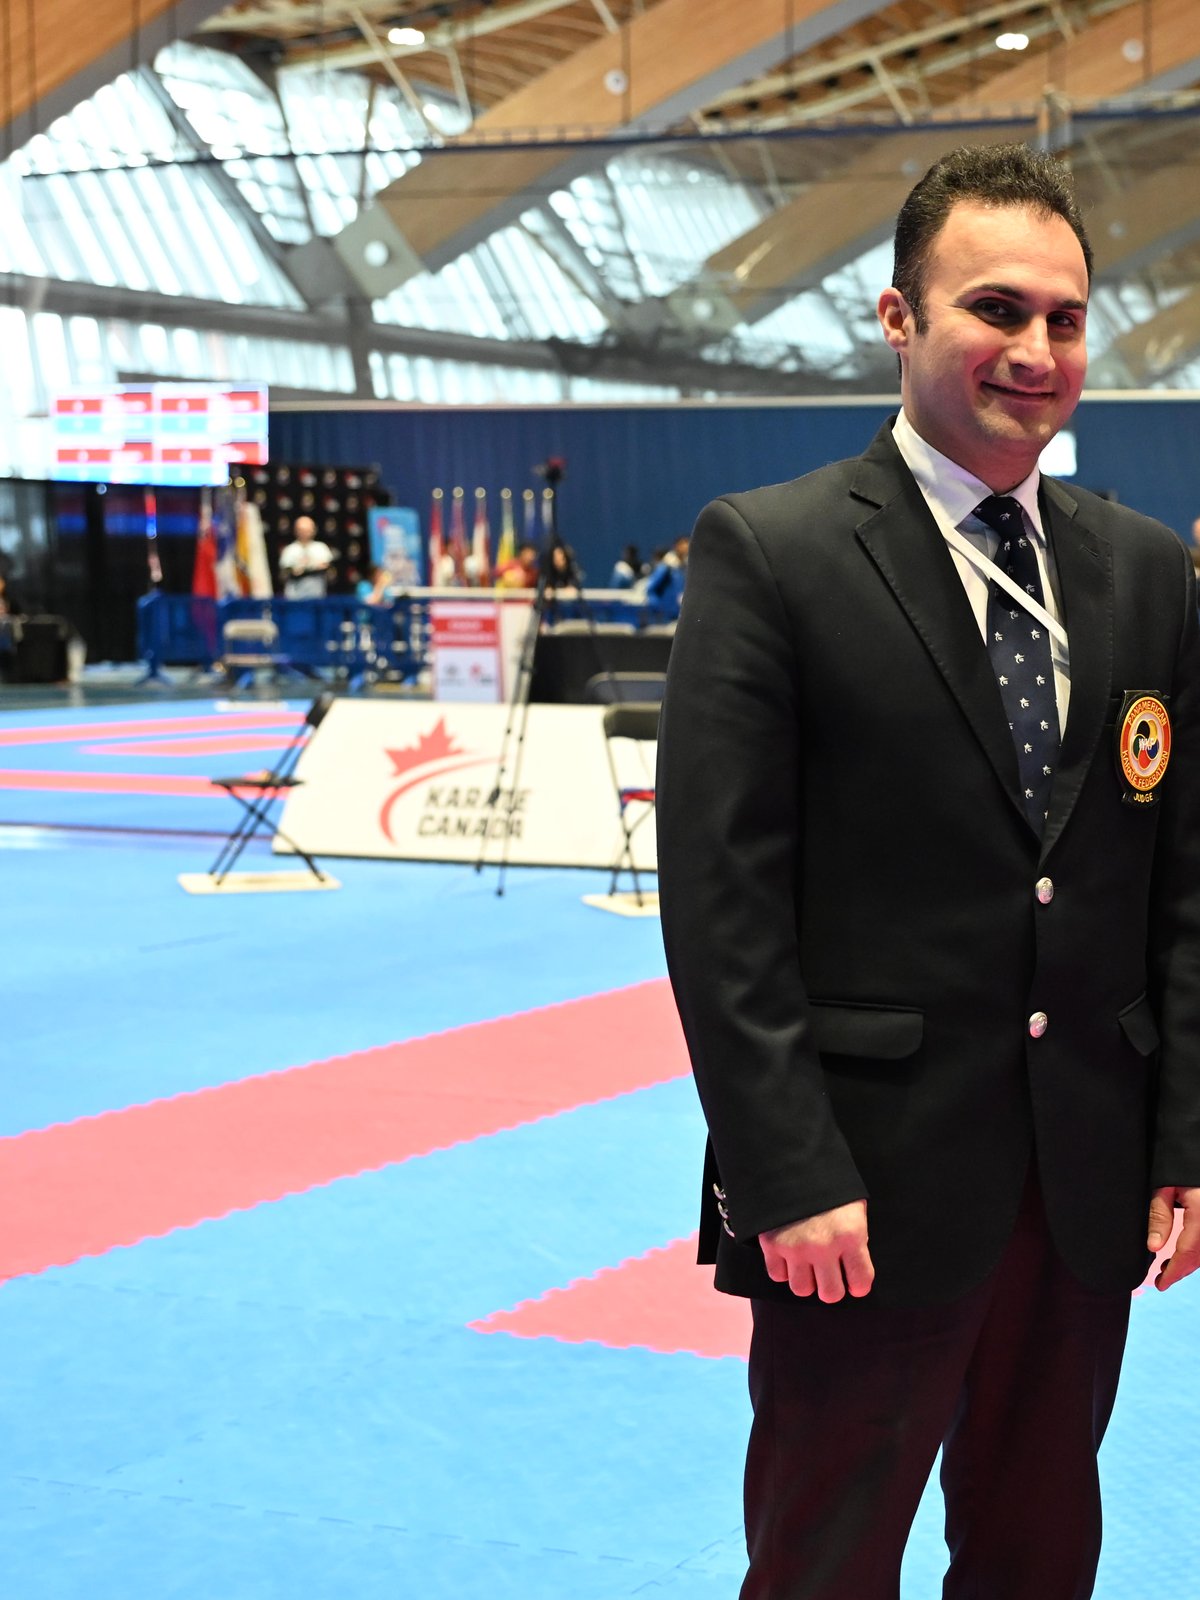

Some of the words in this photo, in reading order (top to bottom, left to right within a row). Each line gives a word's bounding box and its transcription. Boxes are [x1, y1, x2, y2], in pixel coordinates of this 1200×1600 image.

[1127, 700, 1167, 726] PANAMERICAN
[1122, 750, 1138, 781] KARATE
[1138, 750, 1168, 788] FEDERATION
[1133, 792, 1154, 803] JUDGE
[416, 814, 523, 839] CANADA
